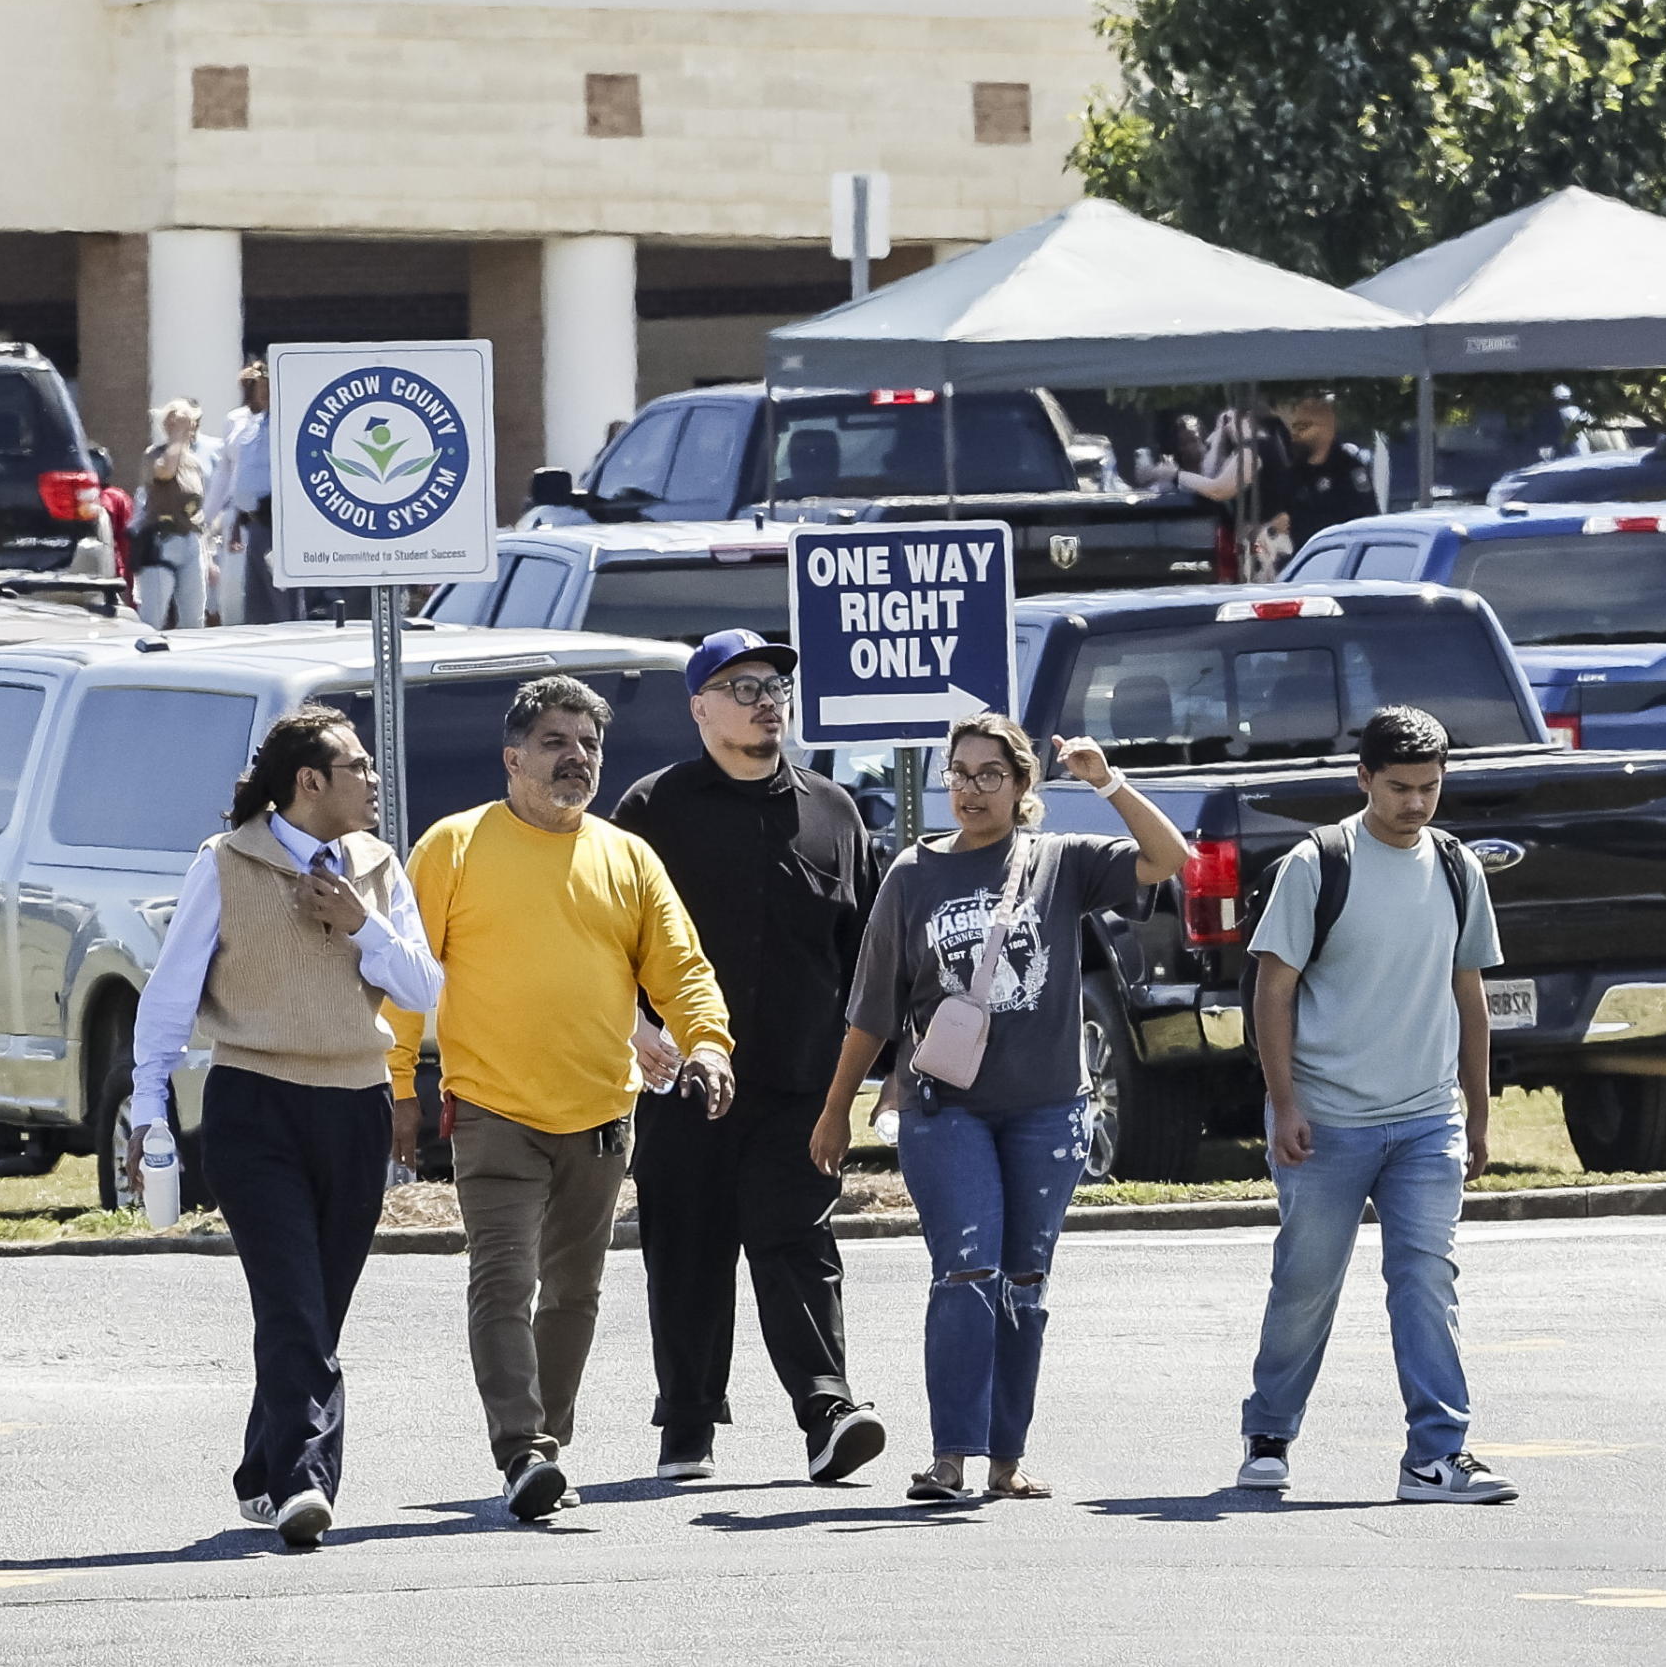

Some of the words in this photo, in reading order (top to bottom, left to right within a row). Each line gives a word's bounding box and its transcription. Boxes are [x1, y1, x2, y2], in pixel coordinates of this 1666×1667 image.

[307, 375, 381, 440] BARROW
[390, 376, 459, 437] COUNTY
[309, 469, 378, 531] SCHOOL
[388, 467, 459, 532] SYSTEM
[303, 551, 330, 564] Boldly
[394, 549, 429, 562] Student
[431, 548, 467, 560] Success
[807, 546, 892, 587] ONE
[904, 542, 996, 583] WAY
[840, 589, 965, 633] RIGHT
[850, 636, 959, 680] ONLY
[947, 950, 967, 962] EST
